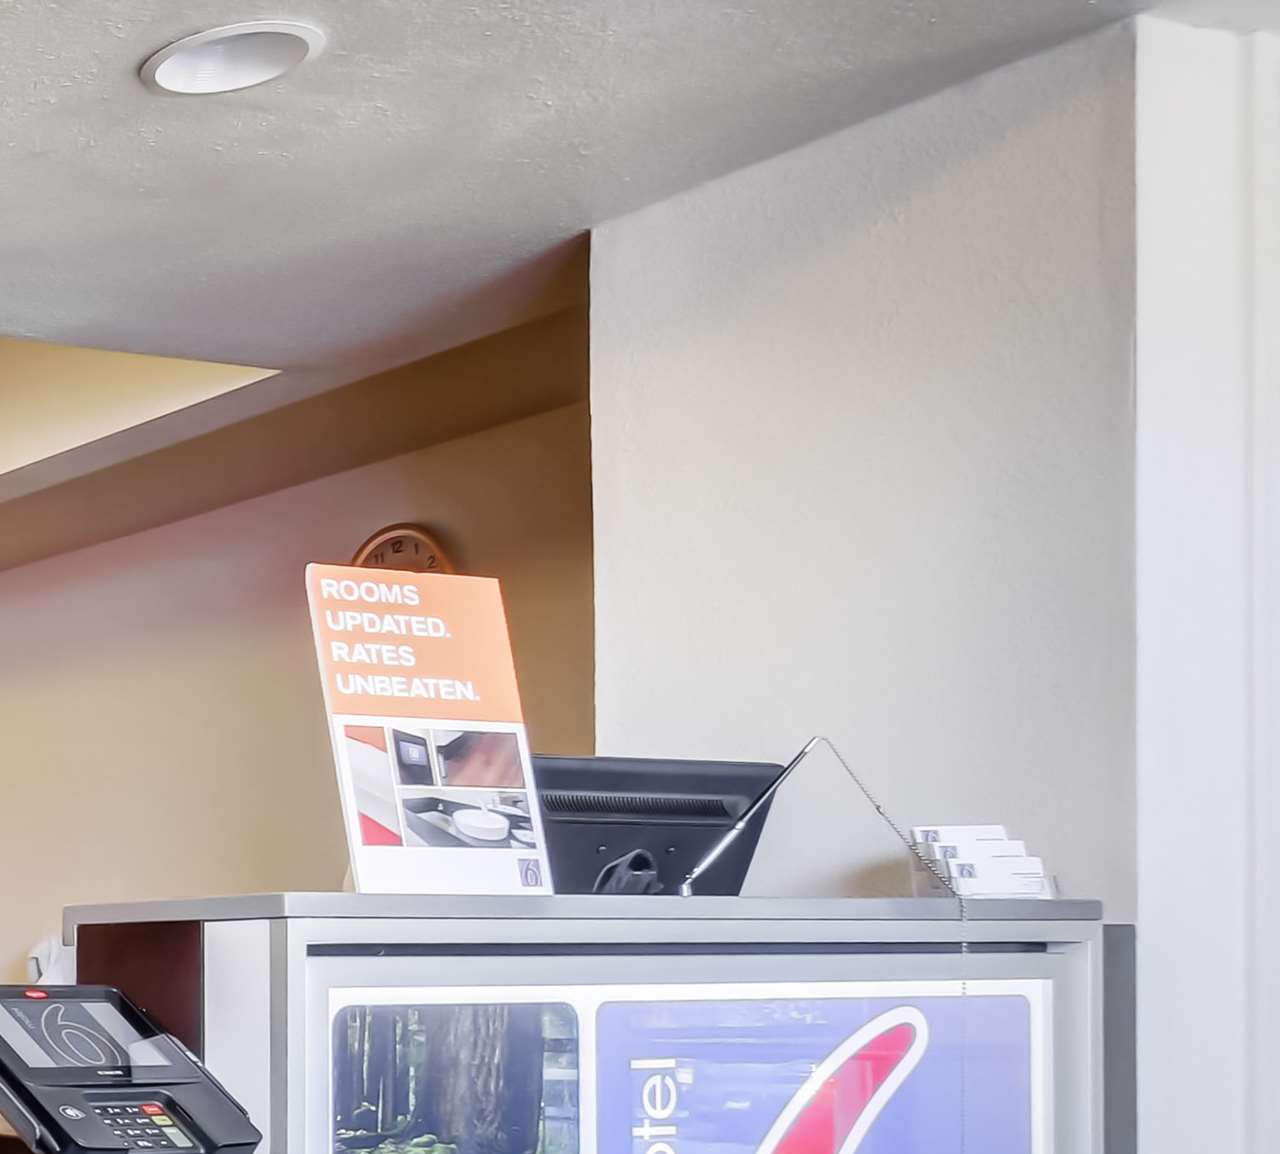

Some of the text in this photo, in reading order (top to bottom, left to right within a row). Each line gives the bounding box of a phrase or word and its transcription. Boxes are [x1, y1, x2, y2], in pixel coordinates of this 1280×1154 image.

[391, 540, 404, 554] 12
[319, 578, 421, 606] ROOMS
[325, 609, 452, 638] UPDATED.
[330, 640, 417, 667] RATES
[335, 672, 481, 702] UNBEATEN.
